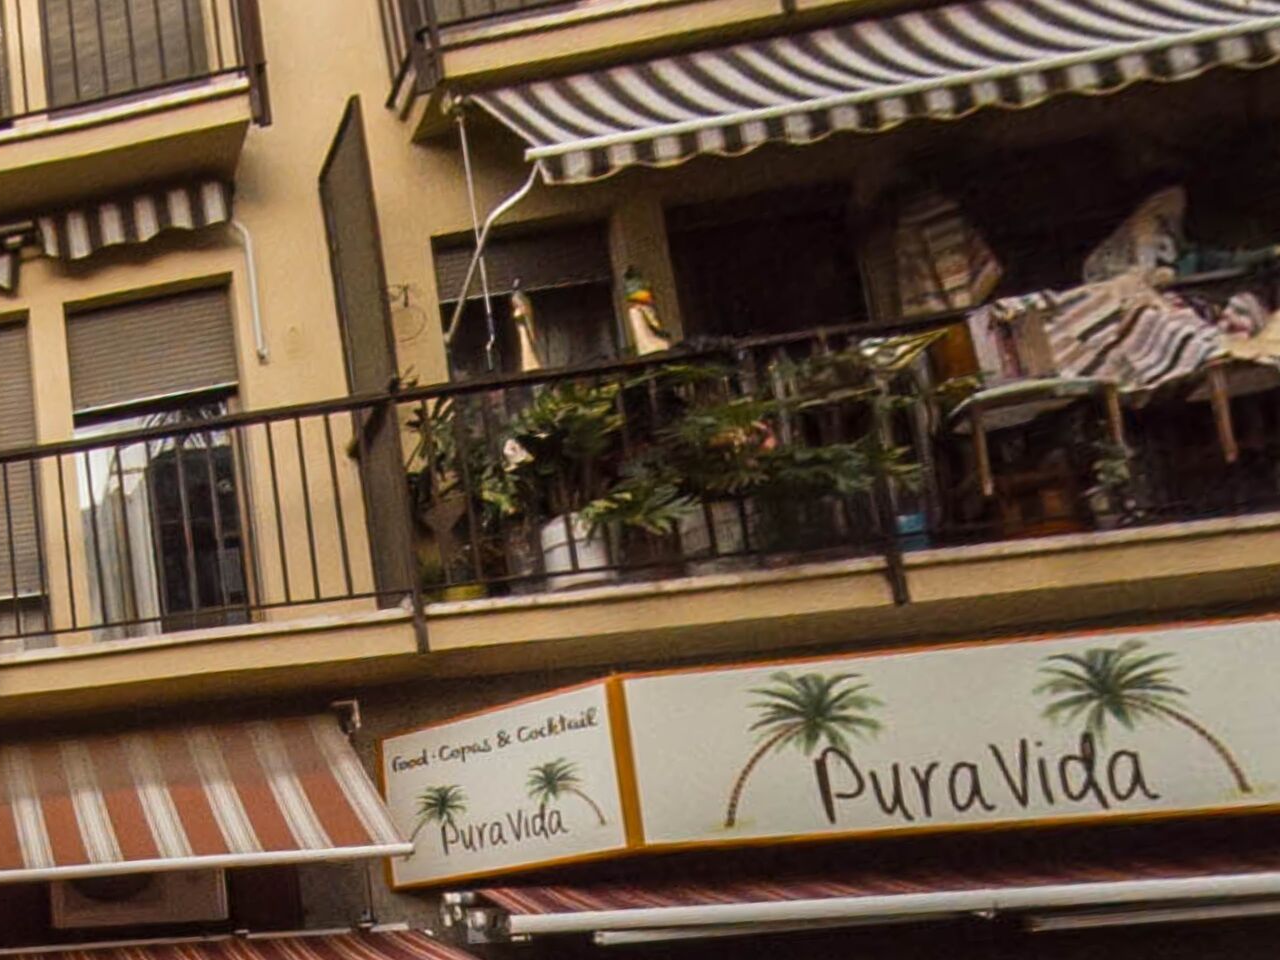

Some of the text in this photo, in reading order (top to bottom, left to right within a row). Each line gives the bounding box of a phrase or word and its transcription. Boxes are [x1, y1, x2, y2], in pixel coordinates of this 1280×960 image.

[439, 738, 493, 762] Copas
[497, 730, 511, 748] &
[517, 708, 598, 743] Cocktail
